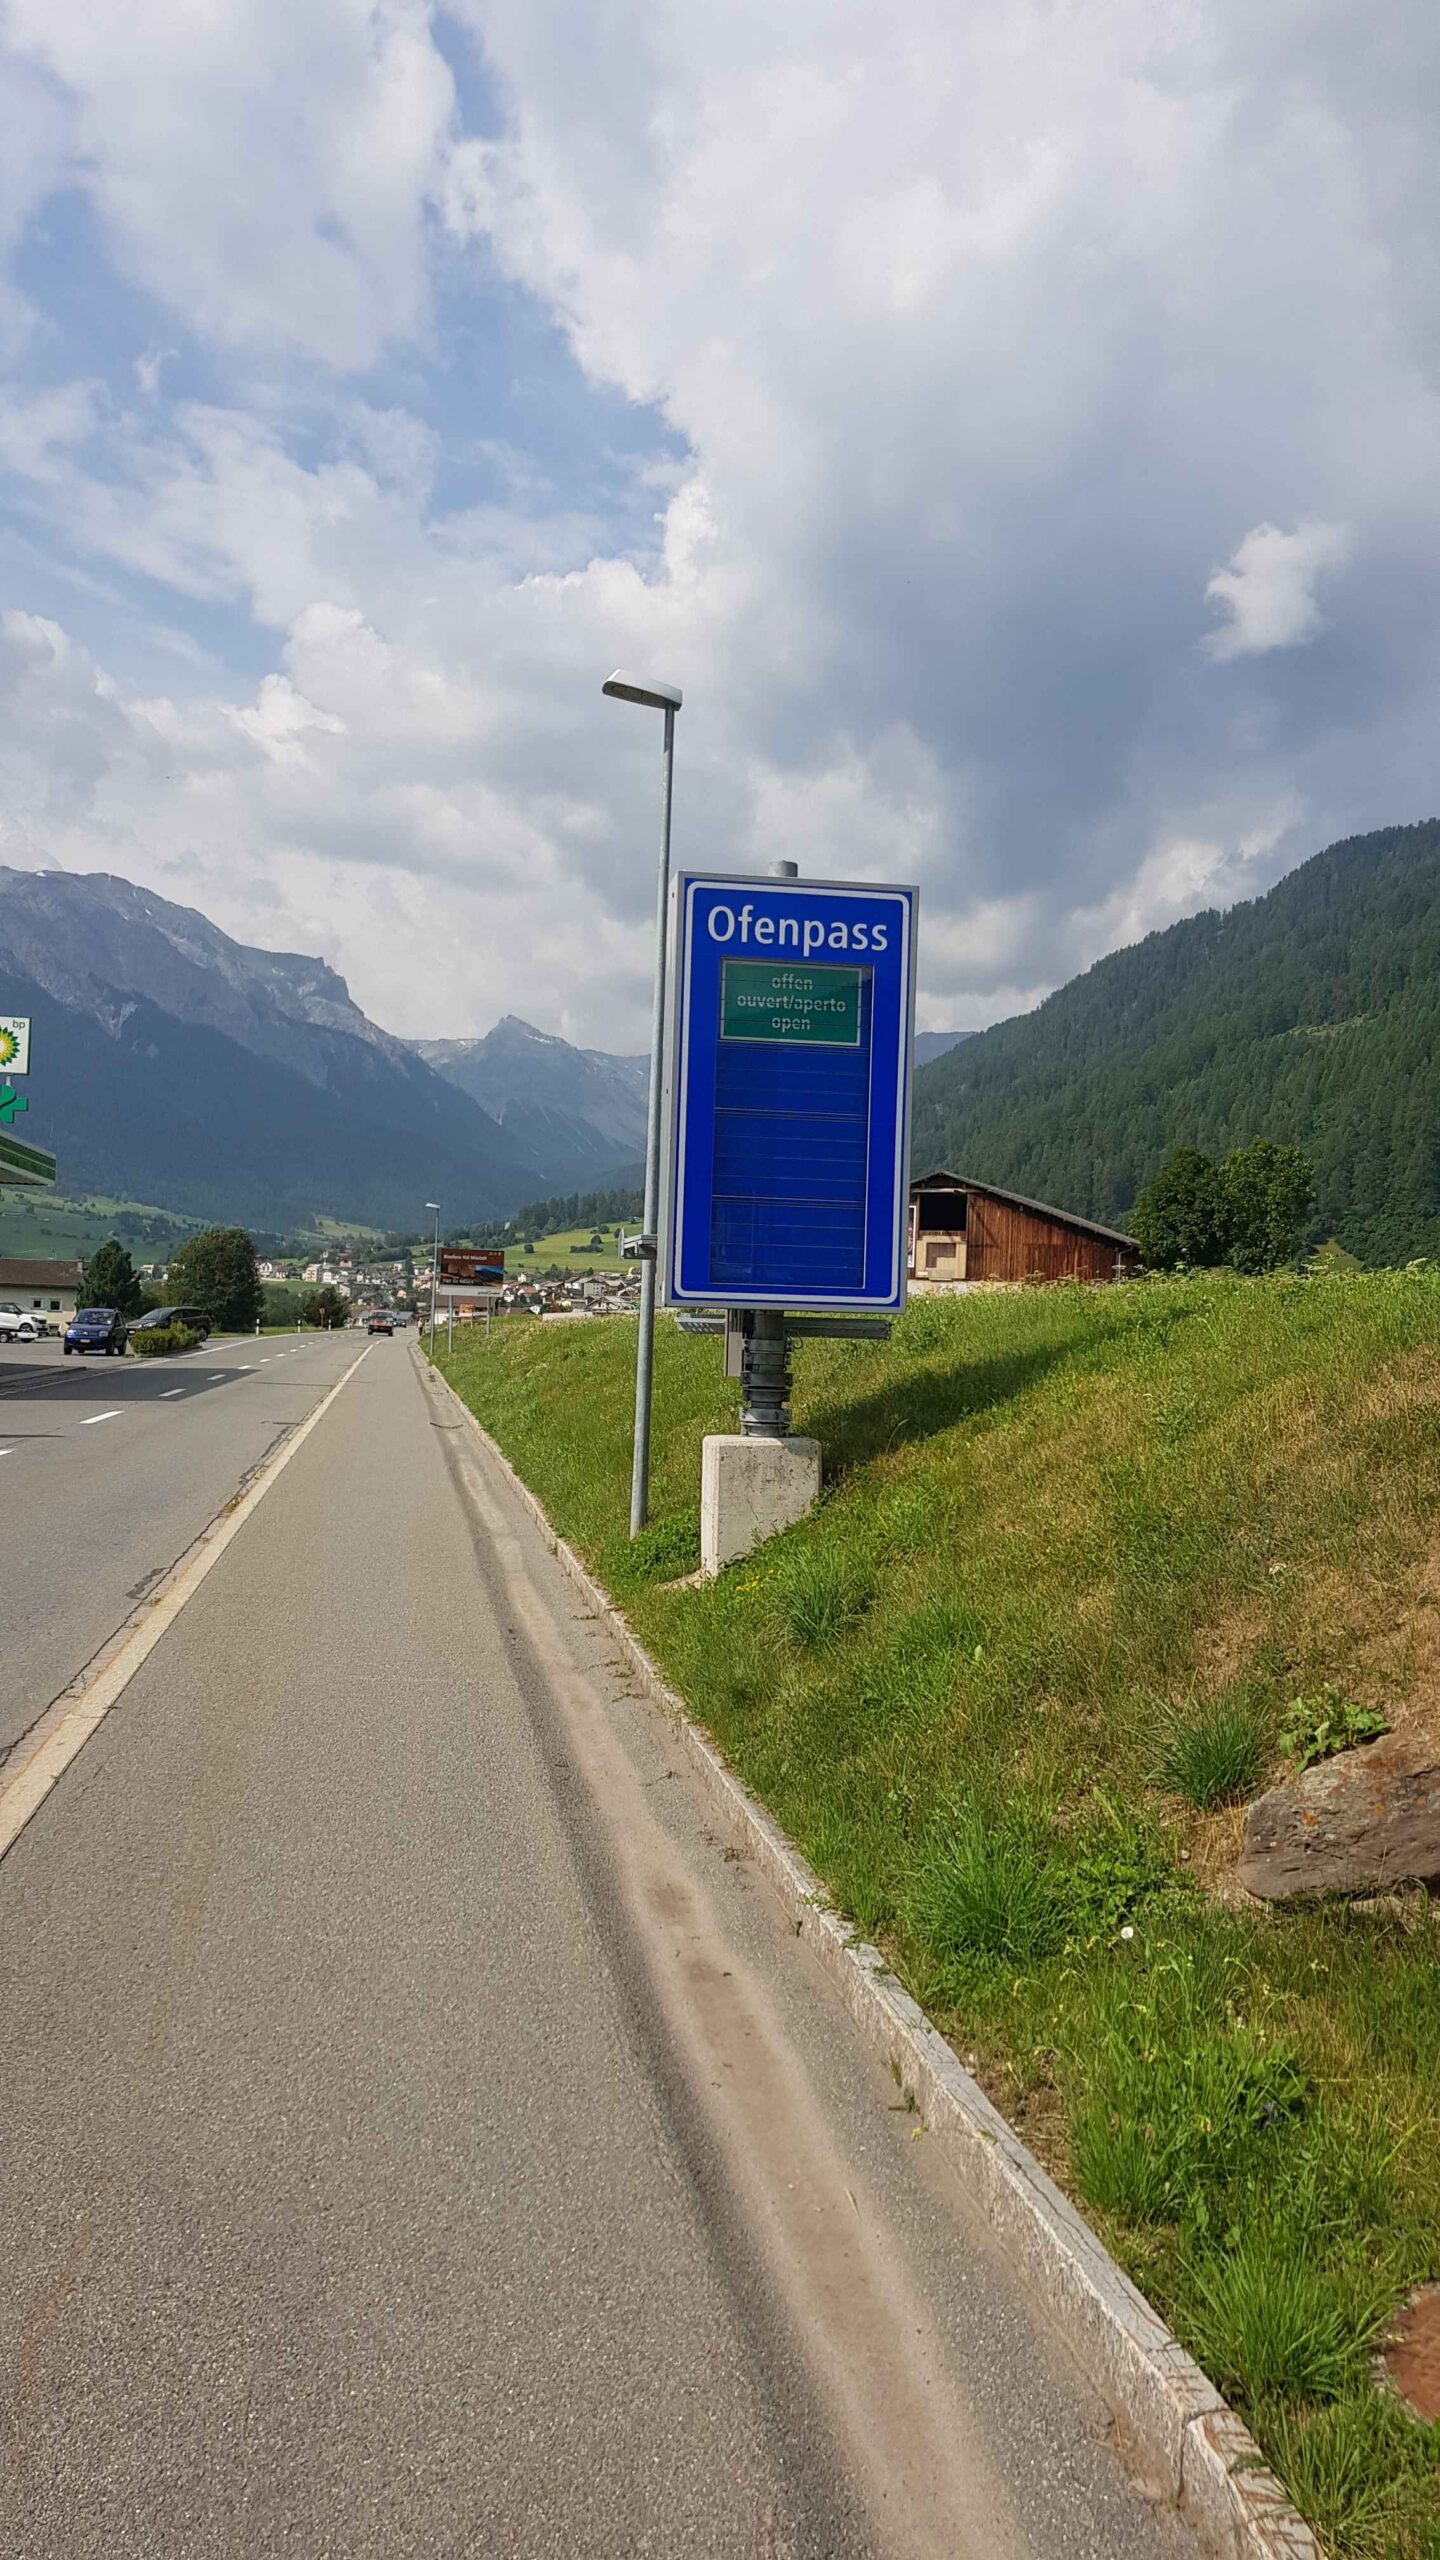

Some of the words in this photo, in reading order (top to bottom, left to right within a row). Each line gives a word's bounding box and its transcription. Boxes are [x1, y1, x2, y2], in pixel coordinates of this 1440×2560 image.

[708, 905, 888, 956] Ofenpass
[772, 974, 813, 990] offen
[737, 994, 846, 1014] ouvert/aperto
[13, 1019, 25, 1030] bp
[772, 1017, 810, 1033] open
